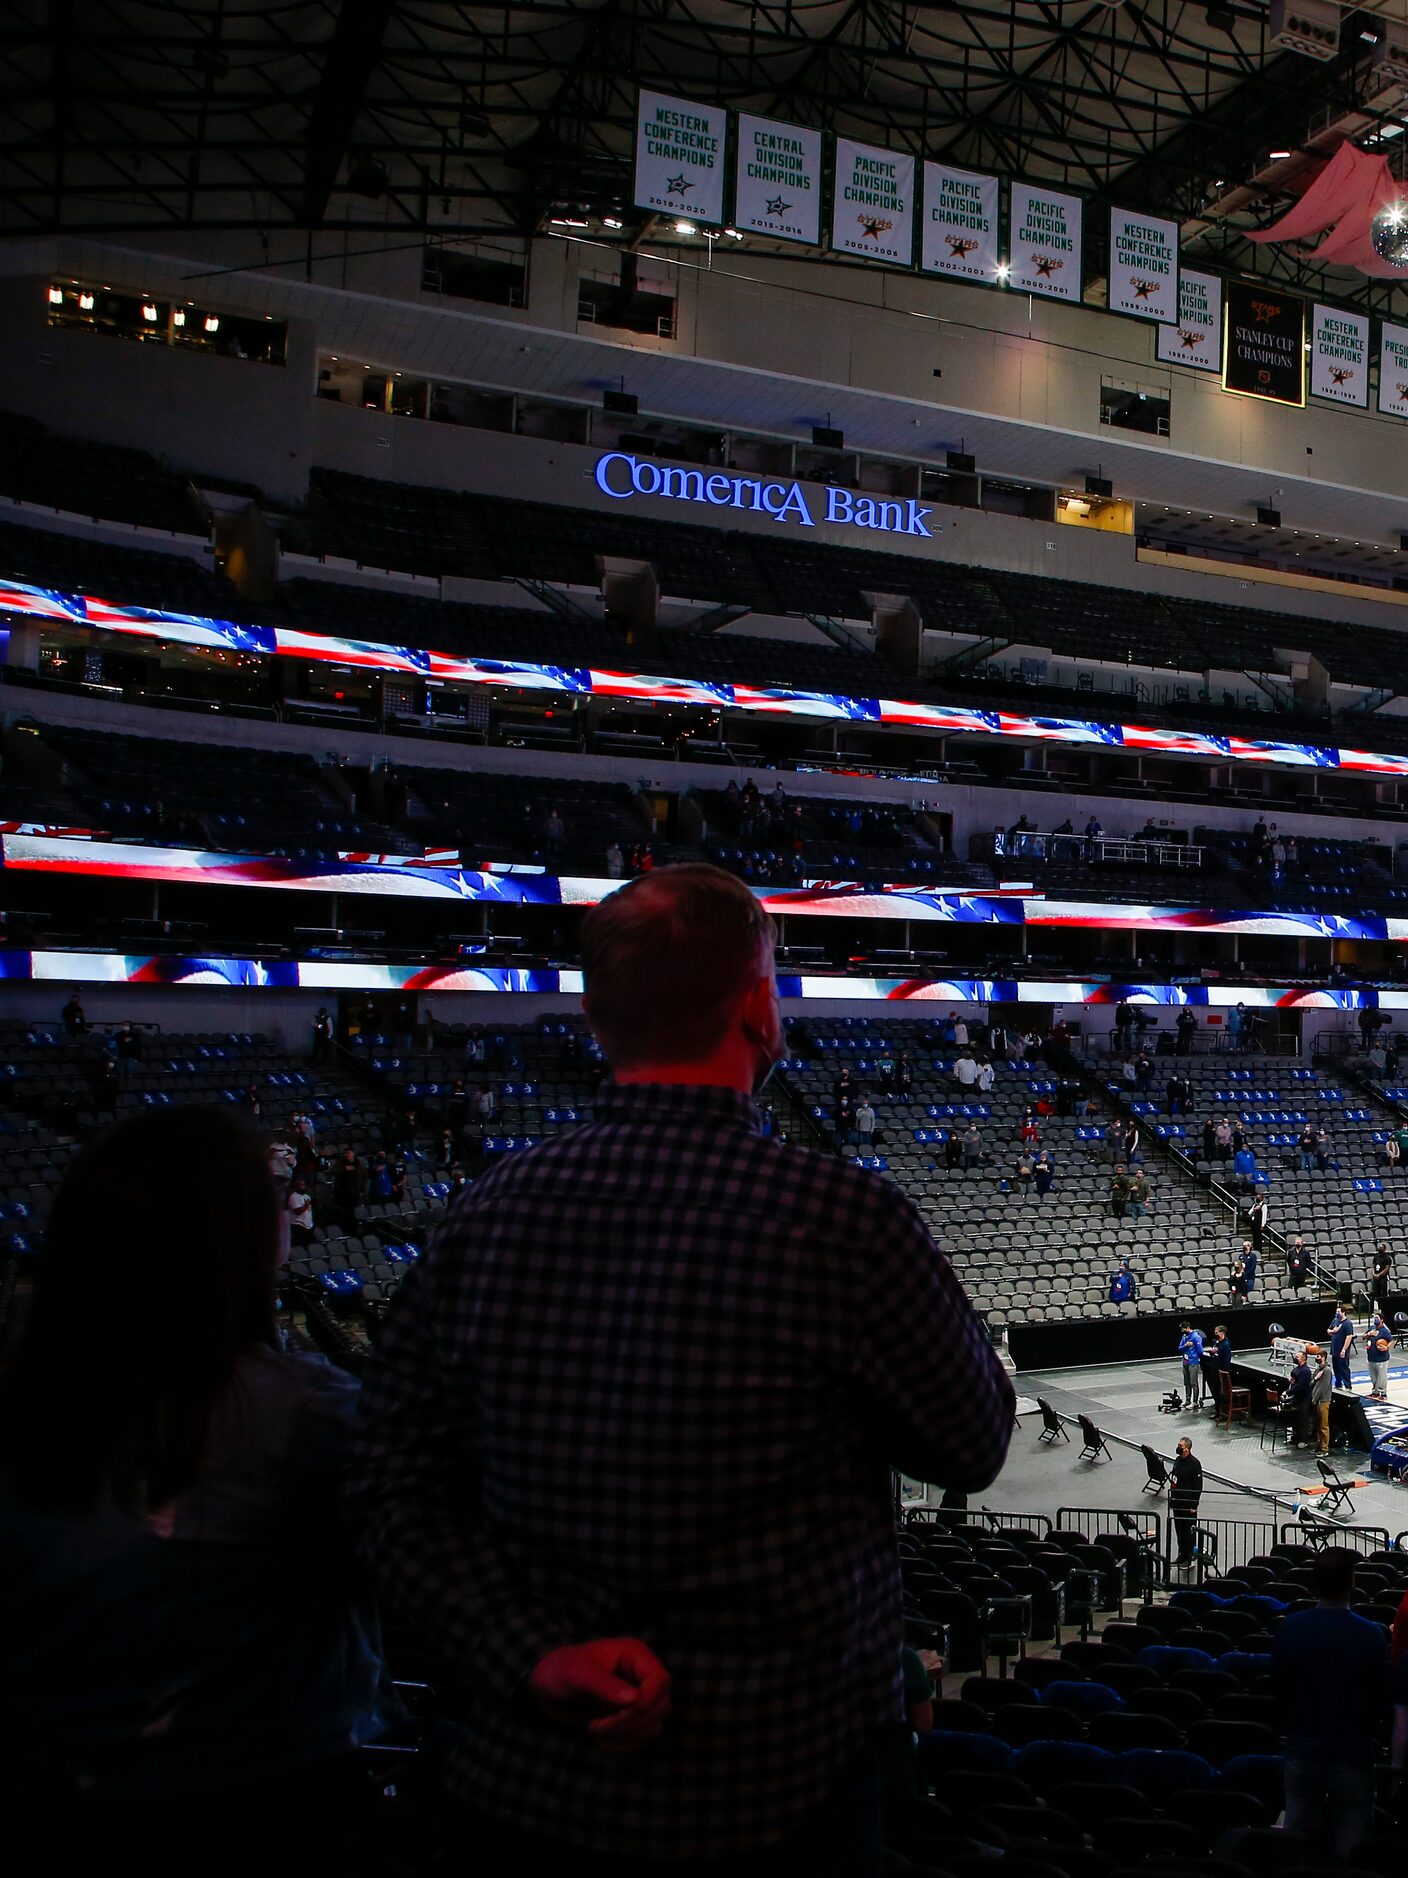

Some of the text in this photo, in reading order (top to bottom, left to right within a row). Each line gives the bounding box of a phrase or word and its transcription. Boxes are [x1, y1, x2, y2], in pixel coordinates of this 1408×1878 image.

[656, 108, 708, 133] WESTERN
[645, 123, 718, 152] CONFERENCE
[754, 132, 804, 155] CENTRAL
[648, 141, 714, 168] CHAMPIONS
[757, 149, 802, 171] DIVISION
[748, 164, 810, 189] CHAMPIONS
[856, 157, 895, 178] PACIFIC
[853, 173, 896, 195] DIVISION
[942, 179, 980, 199] PACIFIC
[650, 198, 705, 214] 2019-2020
[844, 187, 903, 213] CHAMPIONS
[940, 194, 982, 215] DIVISION
[1029, 200, 1064, 219] PACIFIC
[752, 219, 802, 235] 2015-2016
[932, 209, 988, 232] CHAMPIONS
[1027, 215, 1066, 235] DIVISION
[1020, 228, 1072, 252] CHAMPIONS
[1125, 224, 1164, 244] WESTERN
[845, 241, 897, 256] 2005-2006
[1116, 236, 1172, 261] CONFERENCE
[934, 261, 984, 275] 2002-2003
[1119, 252, 1169, 275] CHAMPIONS
[1022, 279, 1068, 294] 2000-2001
[1325, 318, 1358, 336] WESTERN
[1236, 326, 1294, 351] STANLEY CUP
[1318, 330, 1364, 351] CONFERENCE
[1238, 345, 1292, 368] CHAMPIONS
[1320, 344, 1361, 364] CHAMPIONS
[824, 486, 933, 537] Bank
